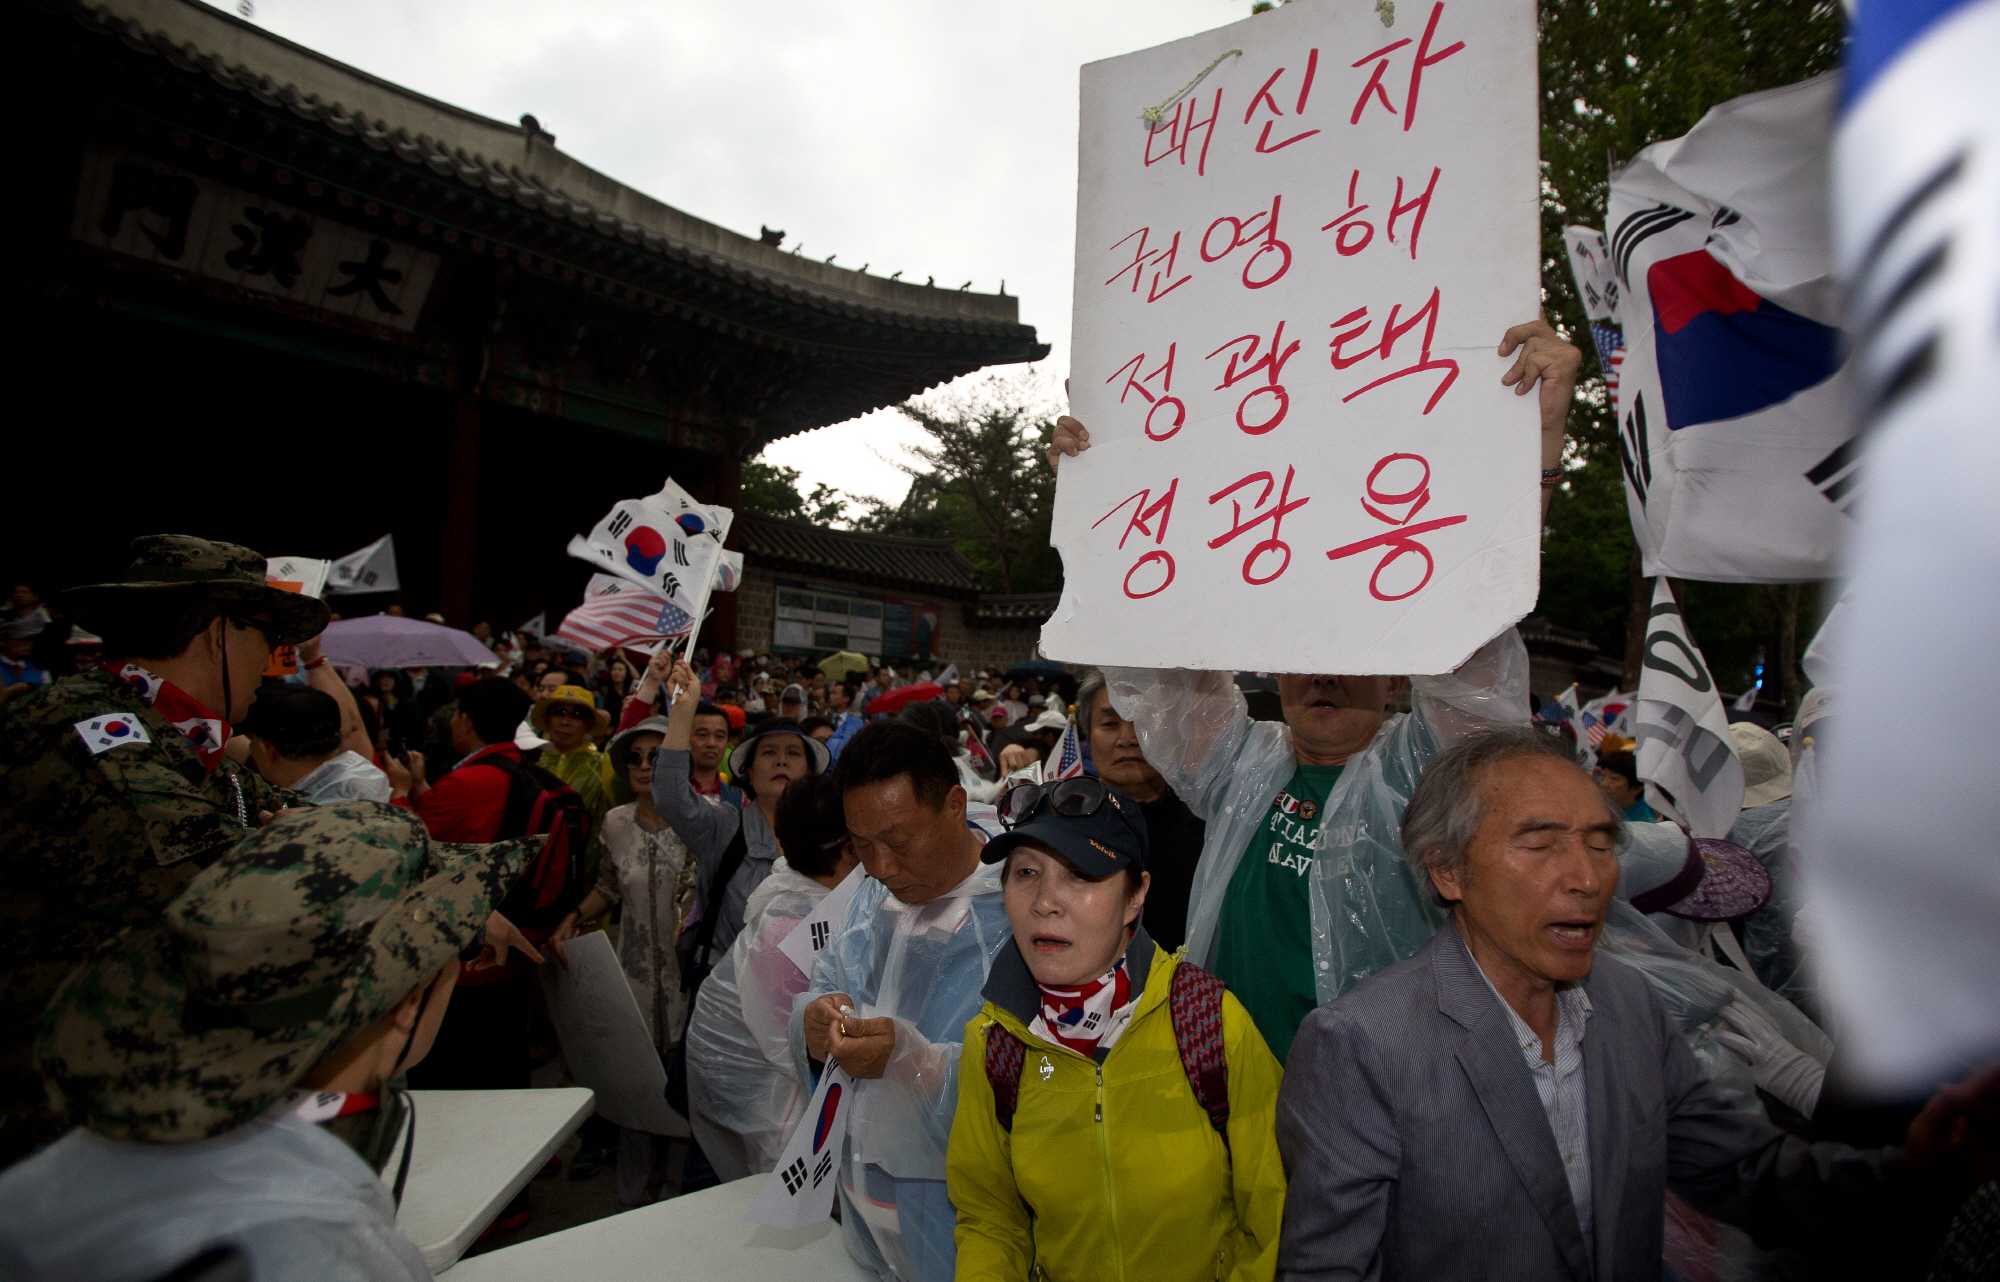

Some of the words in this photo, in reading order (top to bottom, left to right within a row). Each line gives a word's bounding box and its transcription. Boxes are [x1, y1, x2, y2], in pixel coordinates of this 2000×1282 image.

[1143, 1, 1466, 176] 배신자
[1105, 166, 1442, 303] 권영해
[1106, 286, 1460, 442] 정광택
[1088, 838, 1117, 860] Volvik
